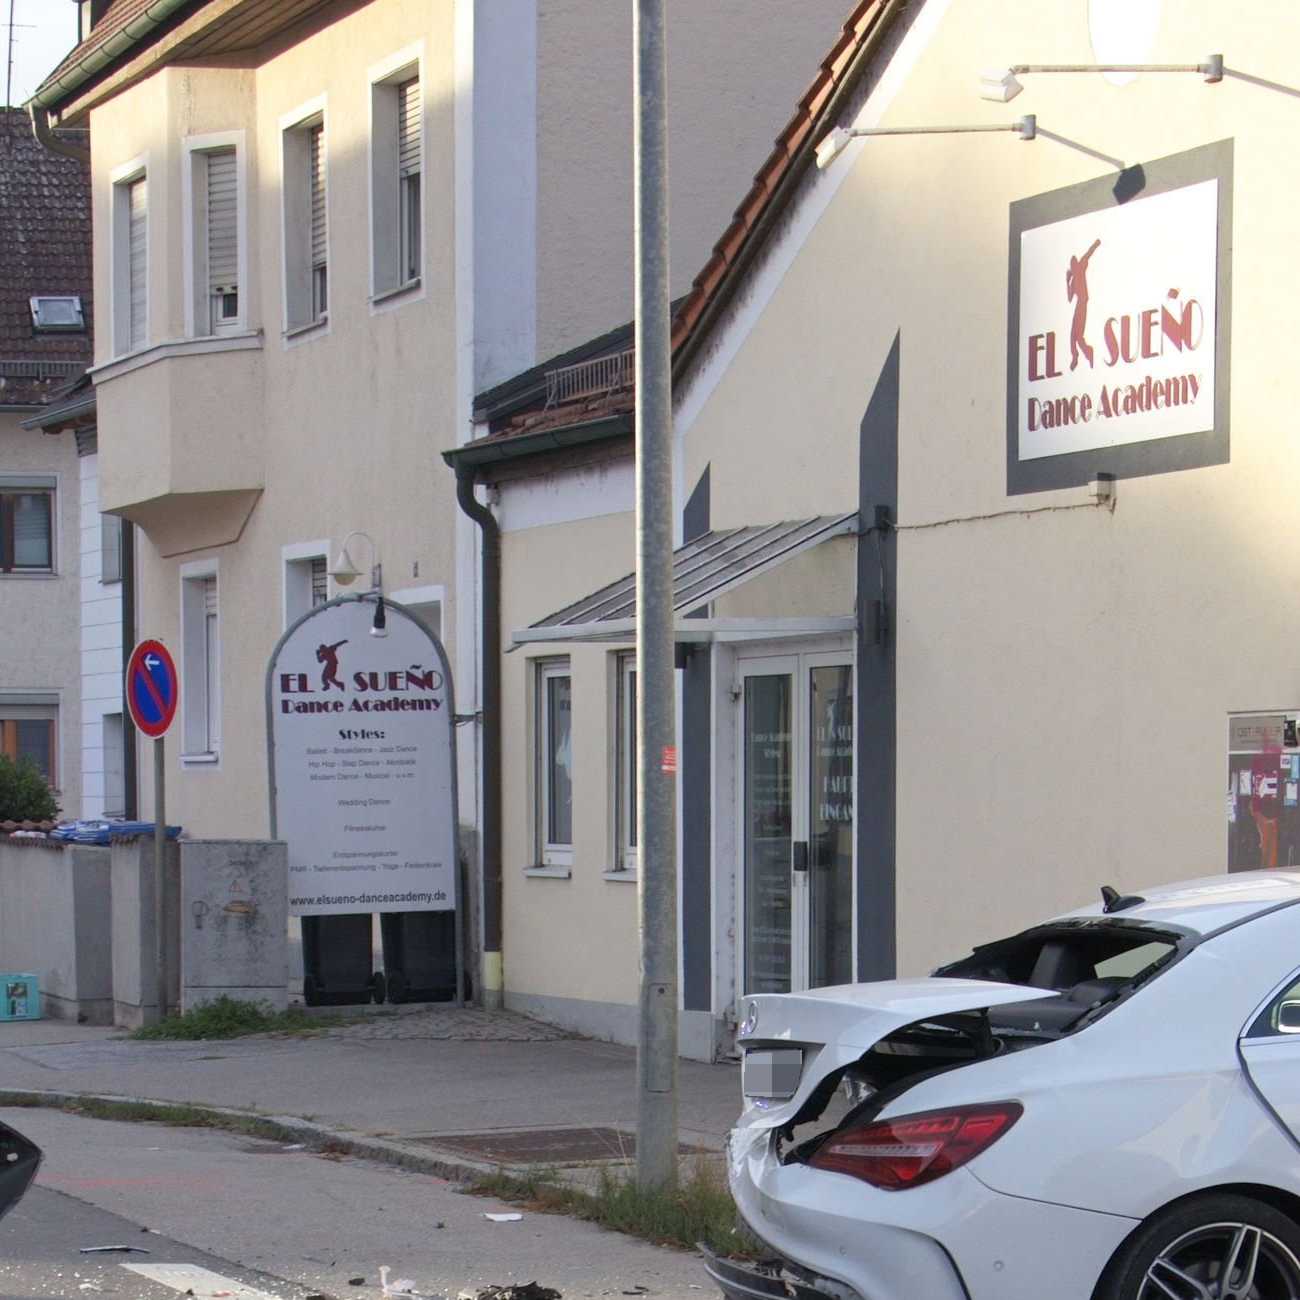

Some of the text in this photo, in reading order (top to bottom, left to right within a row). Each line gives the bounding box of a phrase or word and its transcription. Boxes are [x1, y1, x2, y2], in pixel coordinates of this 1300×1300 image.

[1028, 287, 1204, 382] EL SUEÑO
[1028, 373, 1202, 432] Dance Academy
[280, 664, 444, 694] EL SUEÑO
[281, 696, 444, 715] Dance Academy
[339, 729, 385, 740] Styles:
[334, 746, 373, 754] Breakdance
[308, 761, 320, 769] Hip
[341, 760, 357, 768] Step
[365, 772, 390, 780] Musical
[338, 799, 367, 807] Wedding
[344, 824, 386, 832] Fitnesskurse
[381, 863, 399, 871] Yoga
[290, 890, 446, 906] www.elsueno-danceacademy.de
